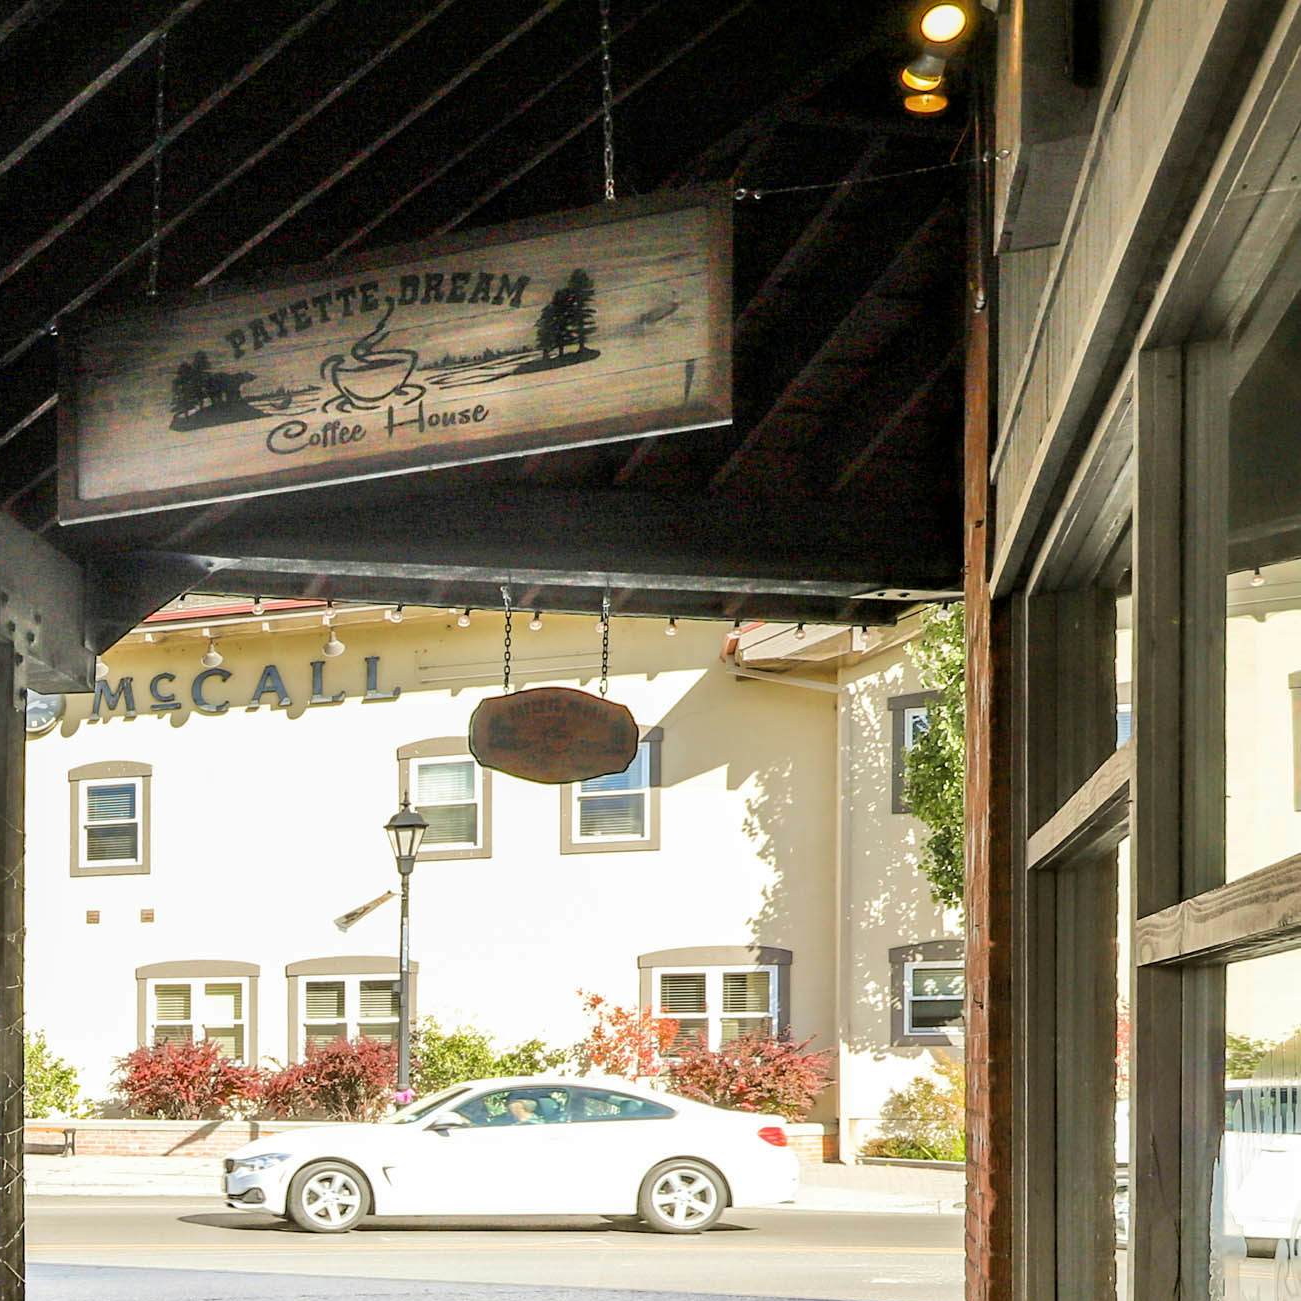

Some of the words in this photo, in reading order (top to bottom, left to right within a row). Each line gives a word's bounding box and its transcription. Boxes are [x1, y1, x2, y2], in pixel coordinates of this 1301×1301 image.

[223, 280, 380, 359] PAYETTE
[398, 271, 532, 309] DREAM
[266, 420, 367, 455] Coffee
[384, 400, 490, 438] House
